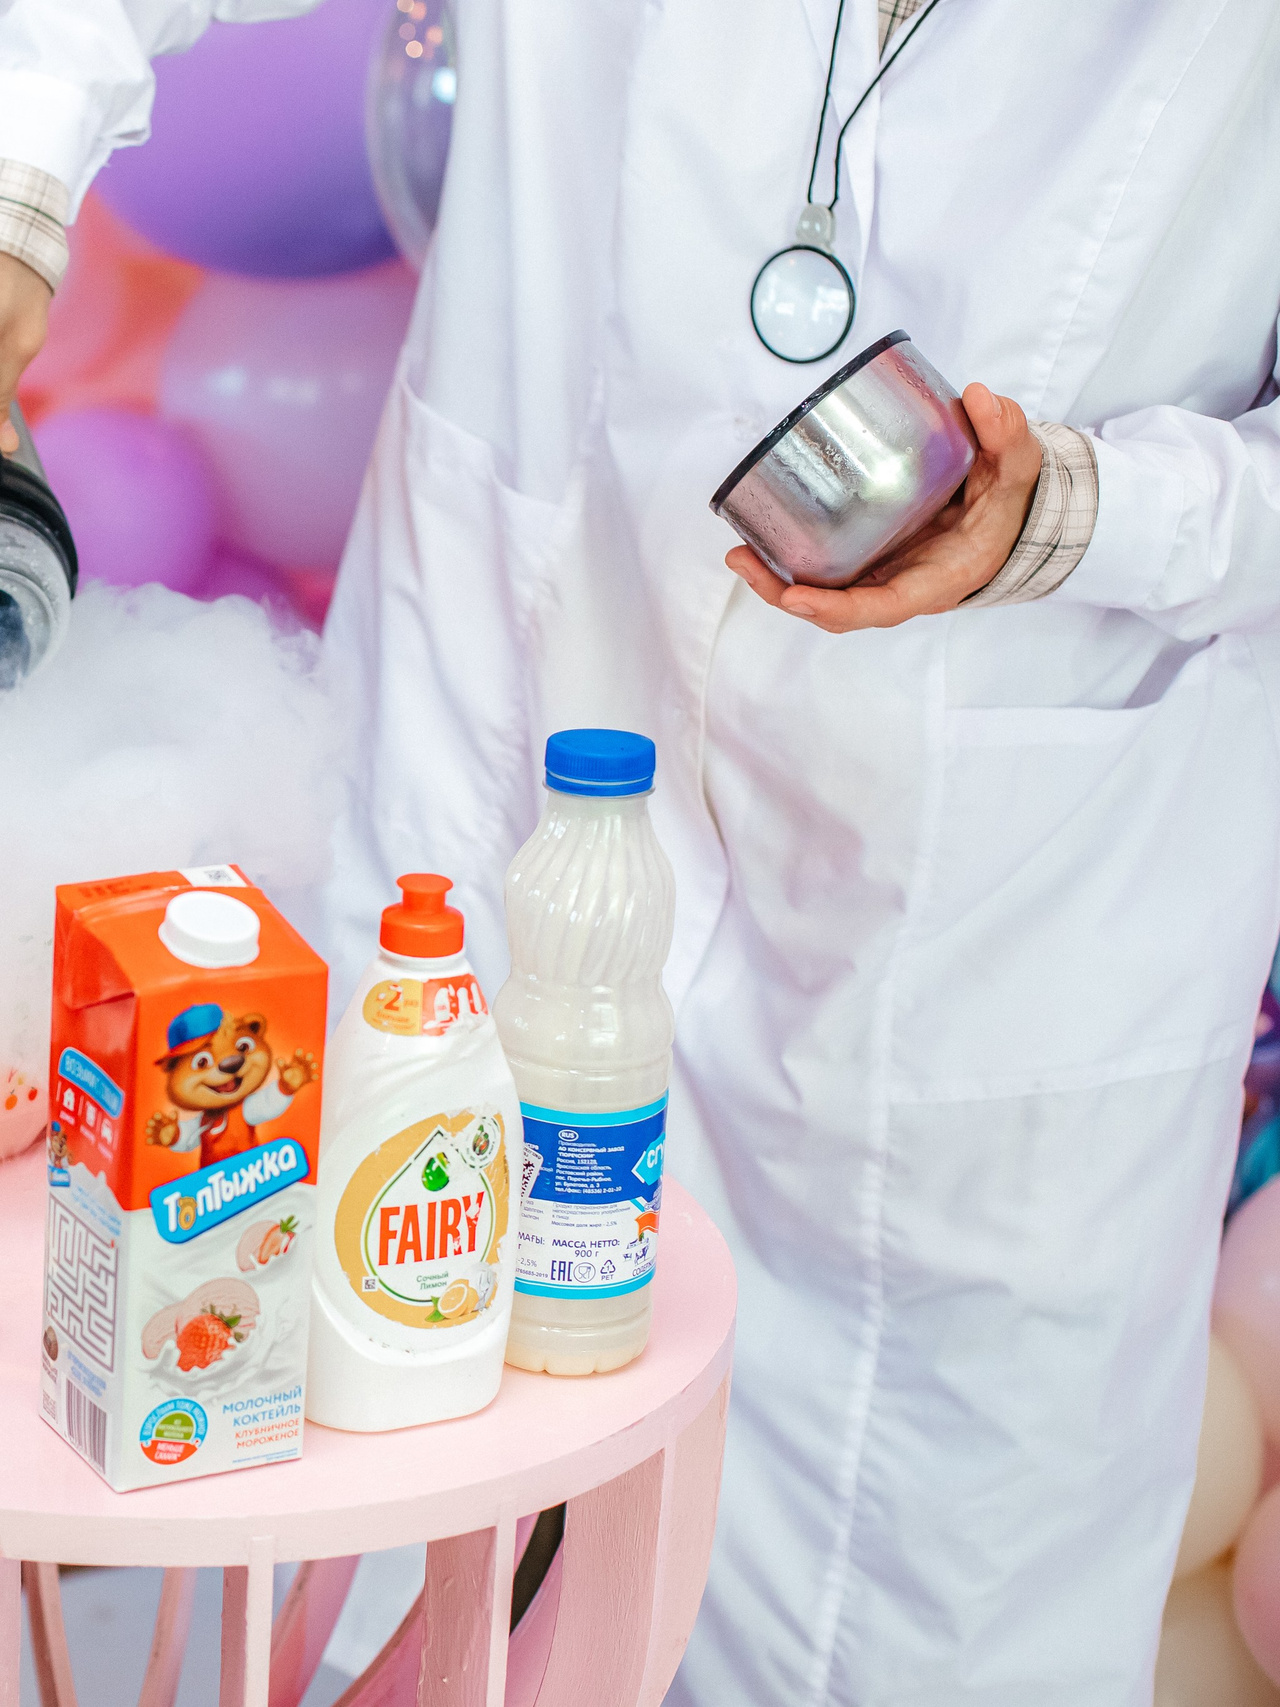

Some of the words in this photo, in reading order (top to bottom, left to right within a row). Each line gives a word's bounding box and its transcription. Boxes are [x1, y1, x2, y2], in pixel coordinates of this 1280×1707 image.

[561, 1131, 575, 1139] RUS
[607, 1145, 625, 1153] ЗАВОД
[552, 1202, 573, 1210] Продукт
[378, 1191, 485, 1266] FAIRY
[552, 1239, 587, 1249] МАССА
[589, 1238, 620, 1248] НЕТТО:
[574, 1249, 592, 1257] 900
[416, 1270, 450, 1283] Сочный
[419, 1280, 448, 1291] Лимон
[222, 1385, 302, 1414] МОЛОЧНЫЙ
[233, 1404, 301, 1427] КОКТЕЙЛЬ
[235, 1418, 300, 1440] КЛУБНИЧНОЕ
[236, 1428, 299, 1449] МОРОЖЕНОЕ
